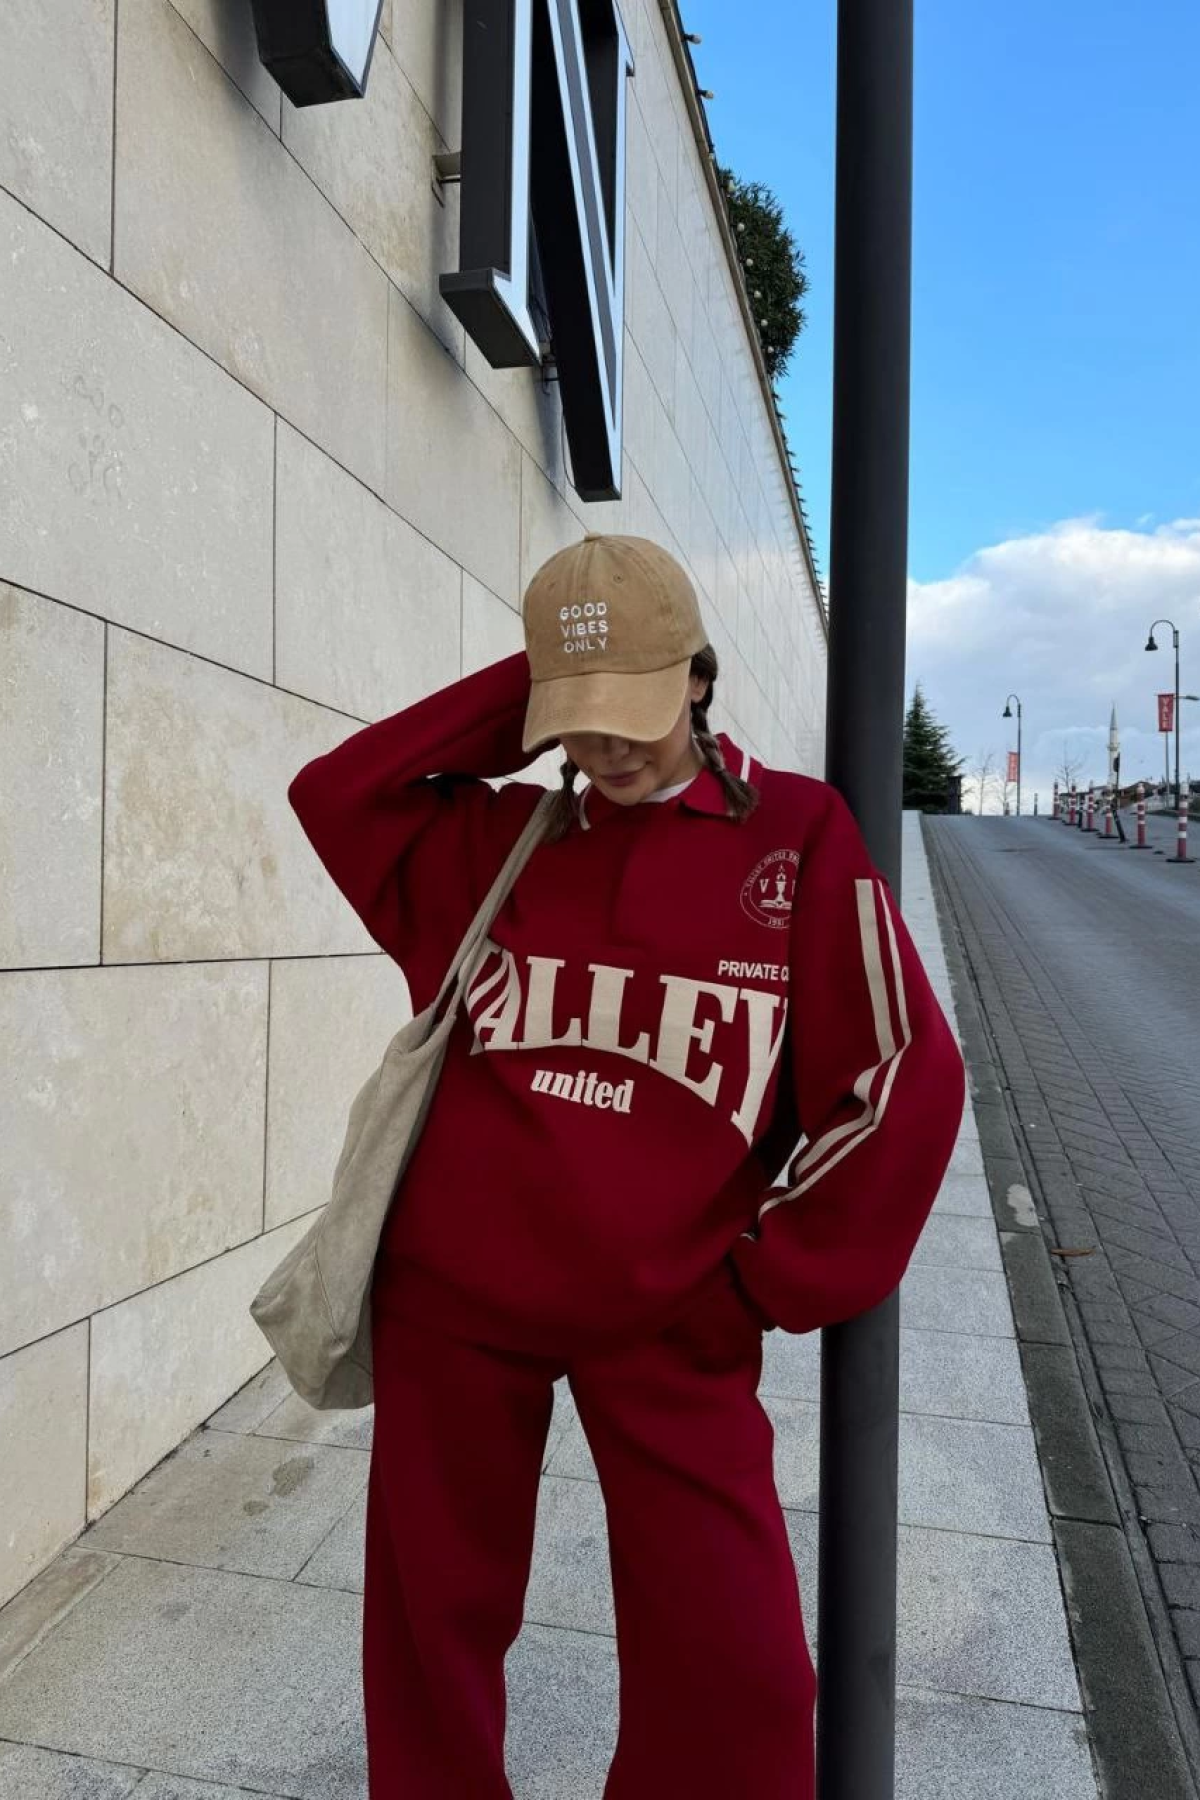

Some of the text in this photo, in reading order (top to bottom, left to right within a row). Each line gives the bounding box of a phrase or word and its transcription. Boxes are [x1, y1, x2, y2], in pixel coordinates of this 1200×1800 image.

[560, 602, 607, 620] GOOD
[560, 620, 609, 638] VIBES
[563, 636, 607, 653] ONLY
[717, 959, 779, 981] PRIVATE
[530, 1069, 634, 1114] united
